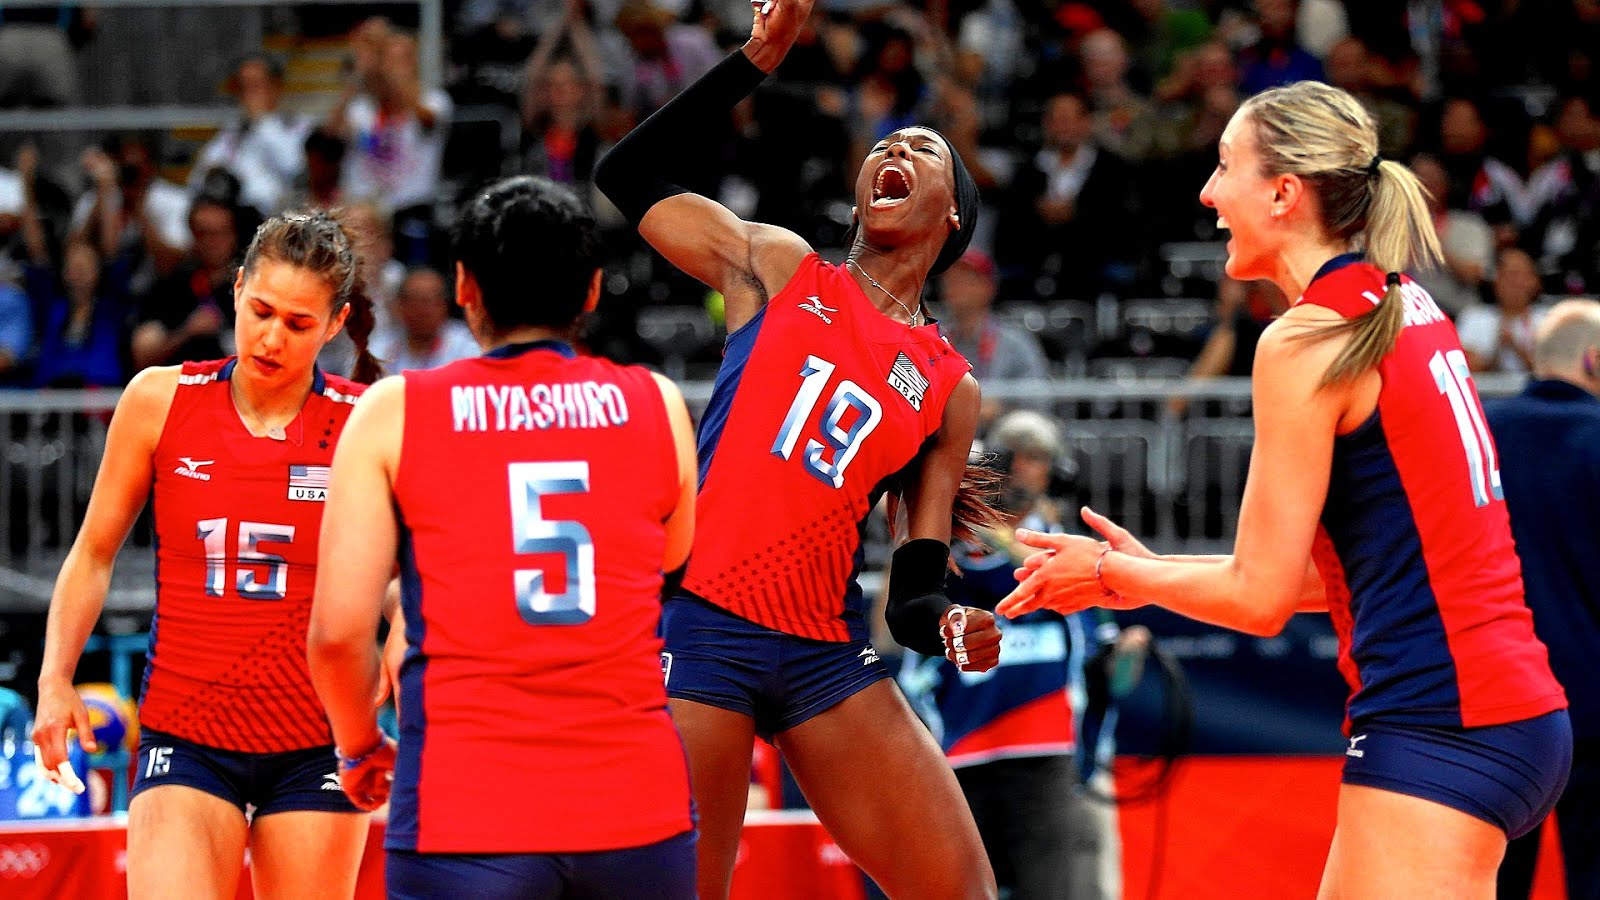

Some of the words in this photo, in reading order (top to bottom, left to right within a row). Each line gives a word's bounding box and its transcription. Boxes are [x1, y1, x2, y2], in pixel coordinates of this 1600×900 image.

[451, 381, 629, 432] MIYASHIRO
[894, 378, 916, 406] USA
[770, 354, 883, 489] 19
[296, 489, 326, 499] USA
[197, 517, 295, 600] 15
[508, 461, 596, 626] 5
[660, 651, 673, 688] 9
[145, 746, 174, 779] 15
